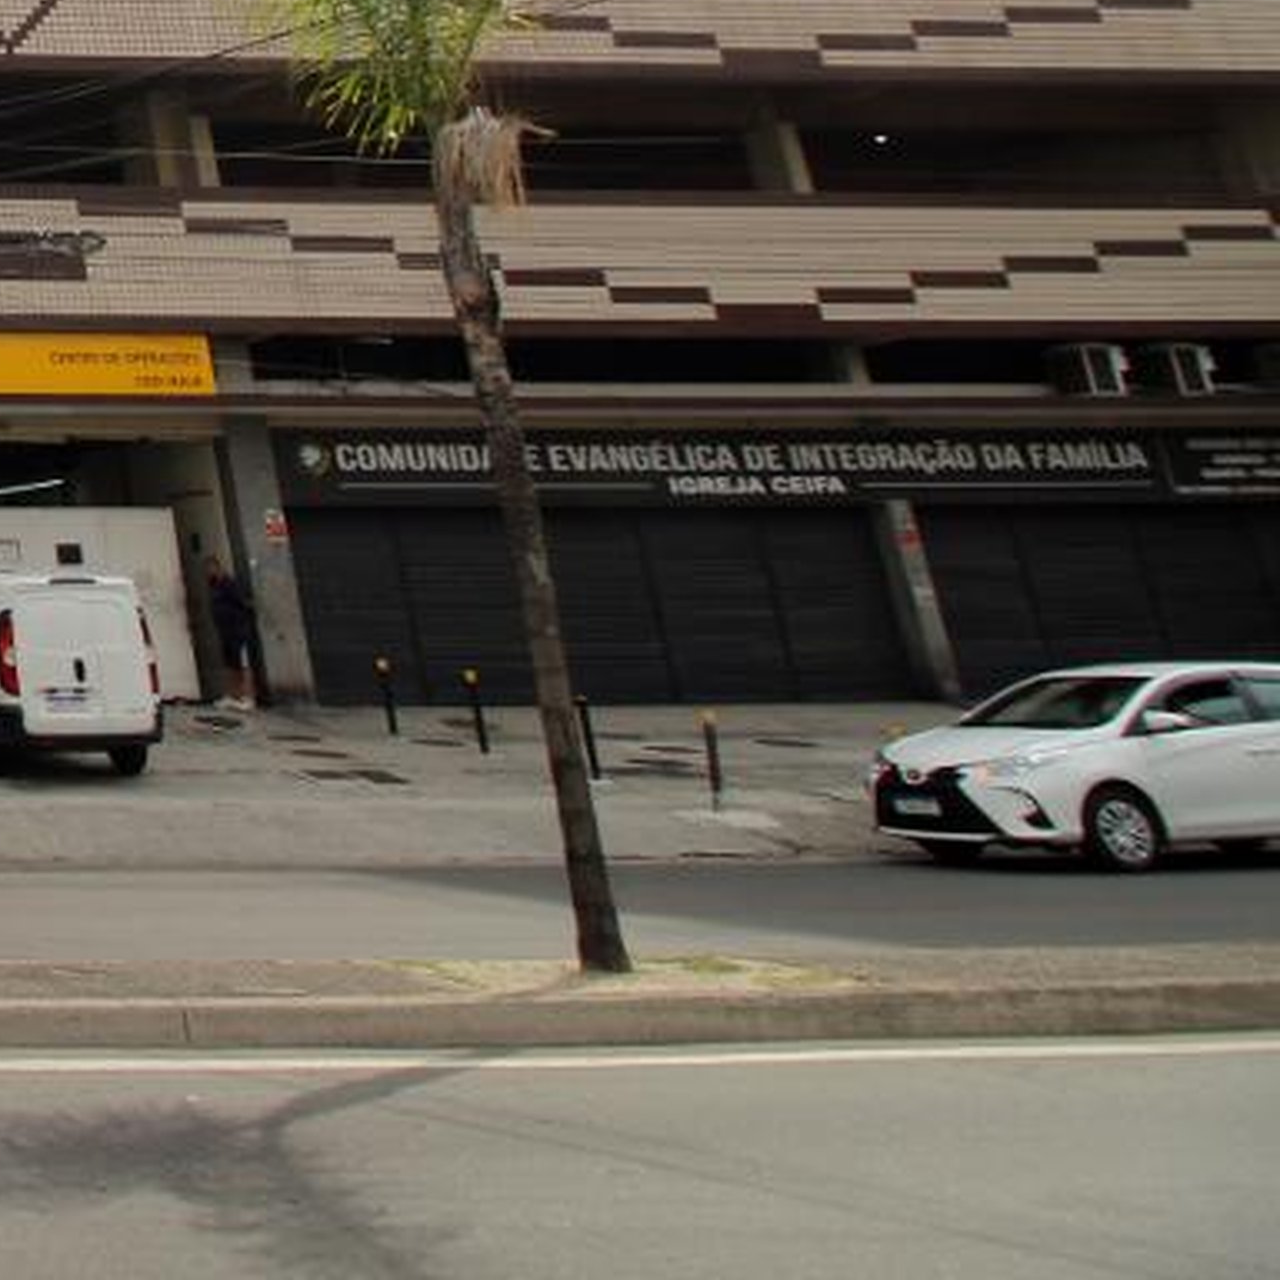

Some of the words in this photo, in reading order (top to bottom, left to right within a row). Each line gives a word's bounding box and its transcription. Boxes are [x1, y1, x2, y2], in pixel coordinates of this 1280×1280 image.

[336, 444, 544, 471] COMUNIDE
[548, 440, 738, 471] EVANGÉLICA
[742, 444, 783, 471] DE
[788, 439, 977, 473] INTEGRAÇÃO
[981, 444, 1025, 470] DA
[1027, 437, 1148, 470] FAMÍLIA
[667, 475, 767, 495] IGREJA
[770, 475, 846, 494] CEIFA
